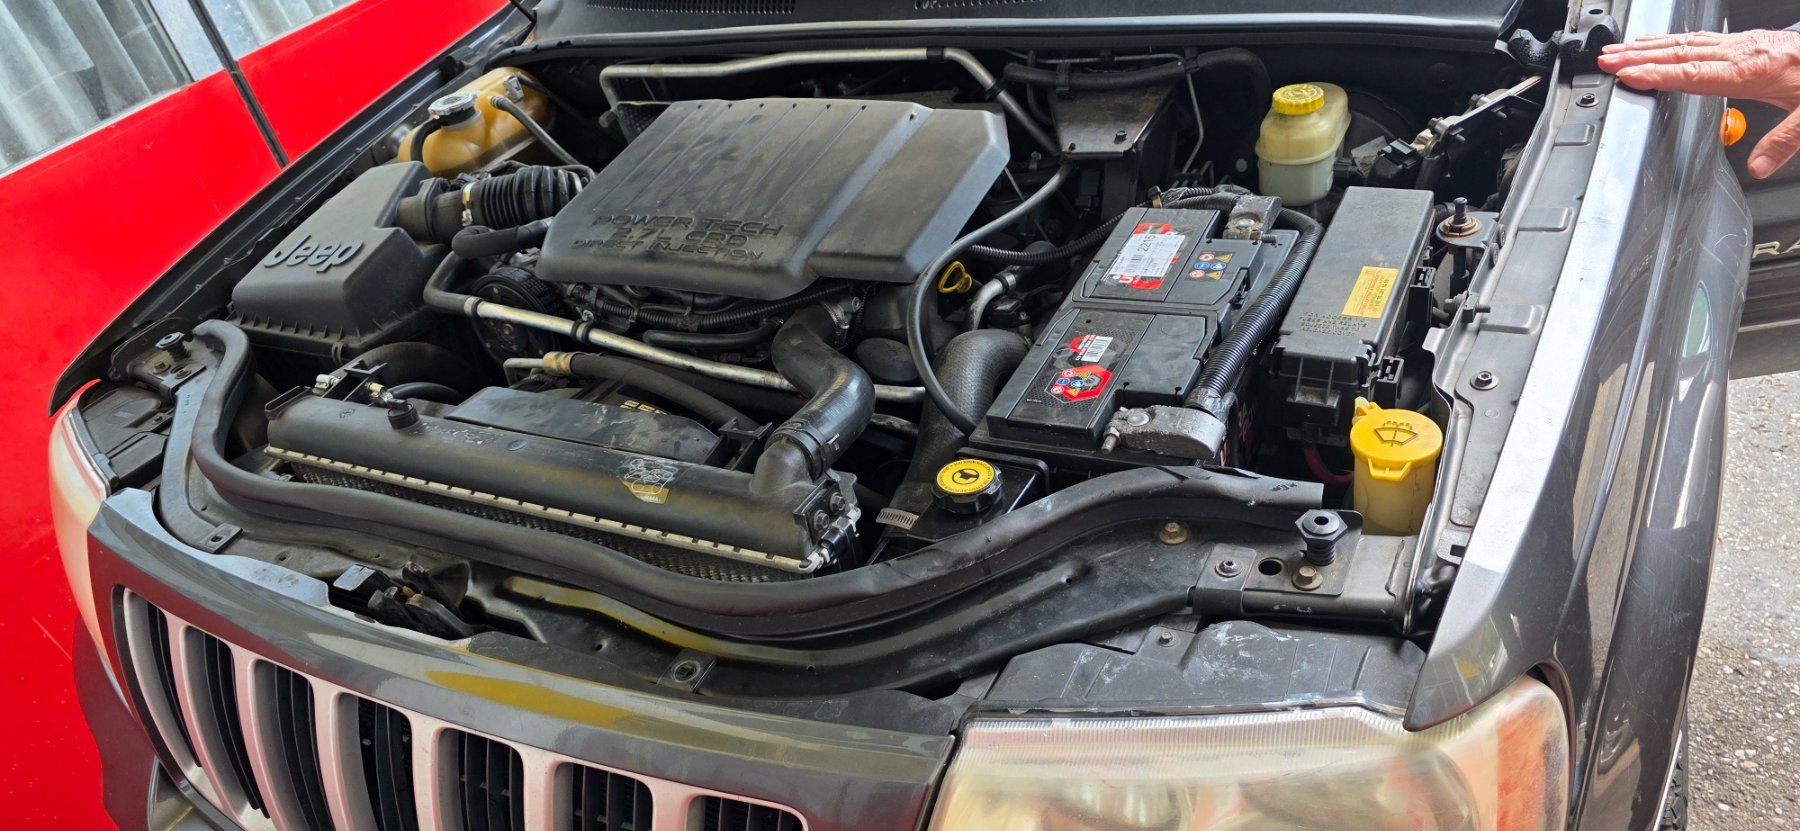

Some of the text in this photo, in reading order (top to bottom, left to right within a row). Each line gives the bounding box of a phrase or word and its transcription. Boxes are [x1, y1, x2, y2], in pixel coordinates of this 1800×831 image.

[592, 215, 785, 237] POWER TECH
[611, 227, 748, 248] 2.7L CRD
[262, 232, 364, 273] Jeep
[571, 238, 765, 261] DIRECT INJECTION
